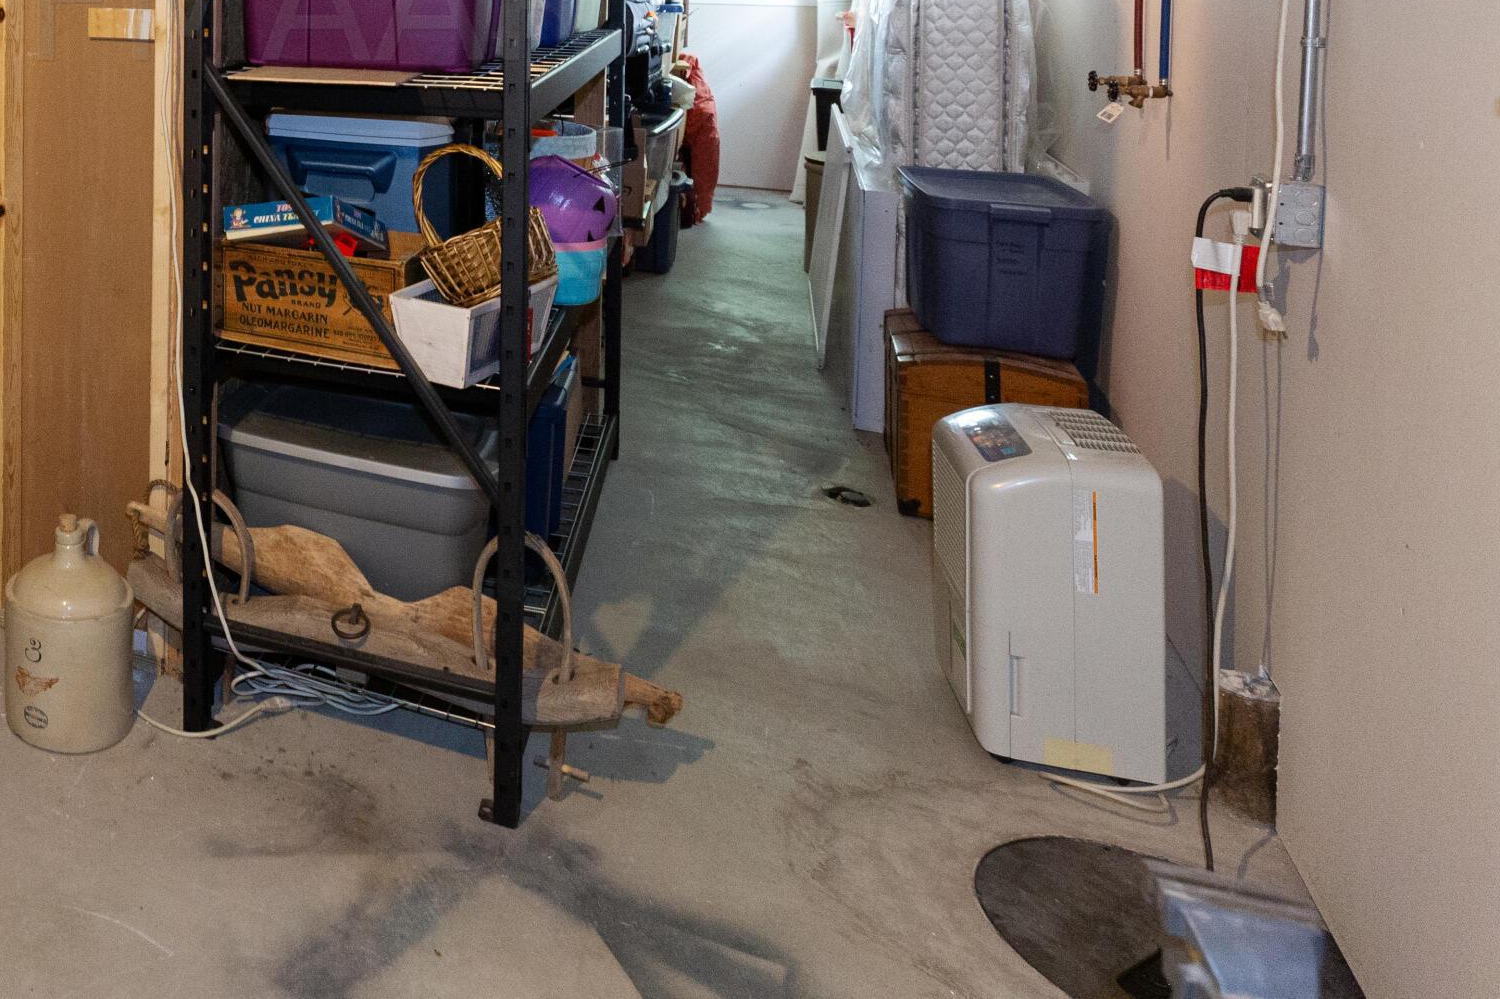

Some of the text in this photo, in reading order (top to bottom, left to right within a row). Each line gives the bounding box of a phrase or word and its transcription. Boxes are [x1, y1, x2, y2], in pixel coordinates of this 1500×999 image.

[229, 260, 337, 307] Pansy
[242, 303, 328, 325] NUT MARGARIN
[291, 299, 321, 309] BRAND
[239, 315, 330, 339] OLEOMARGARINE
